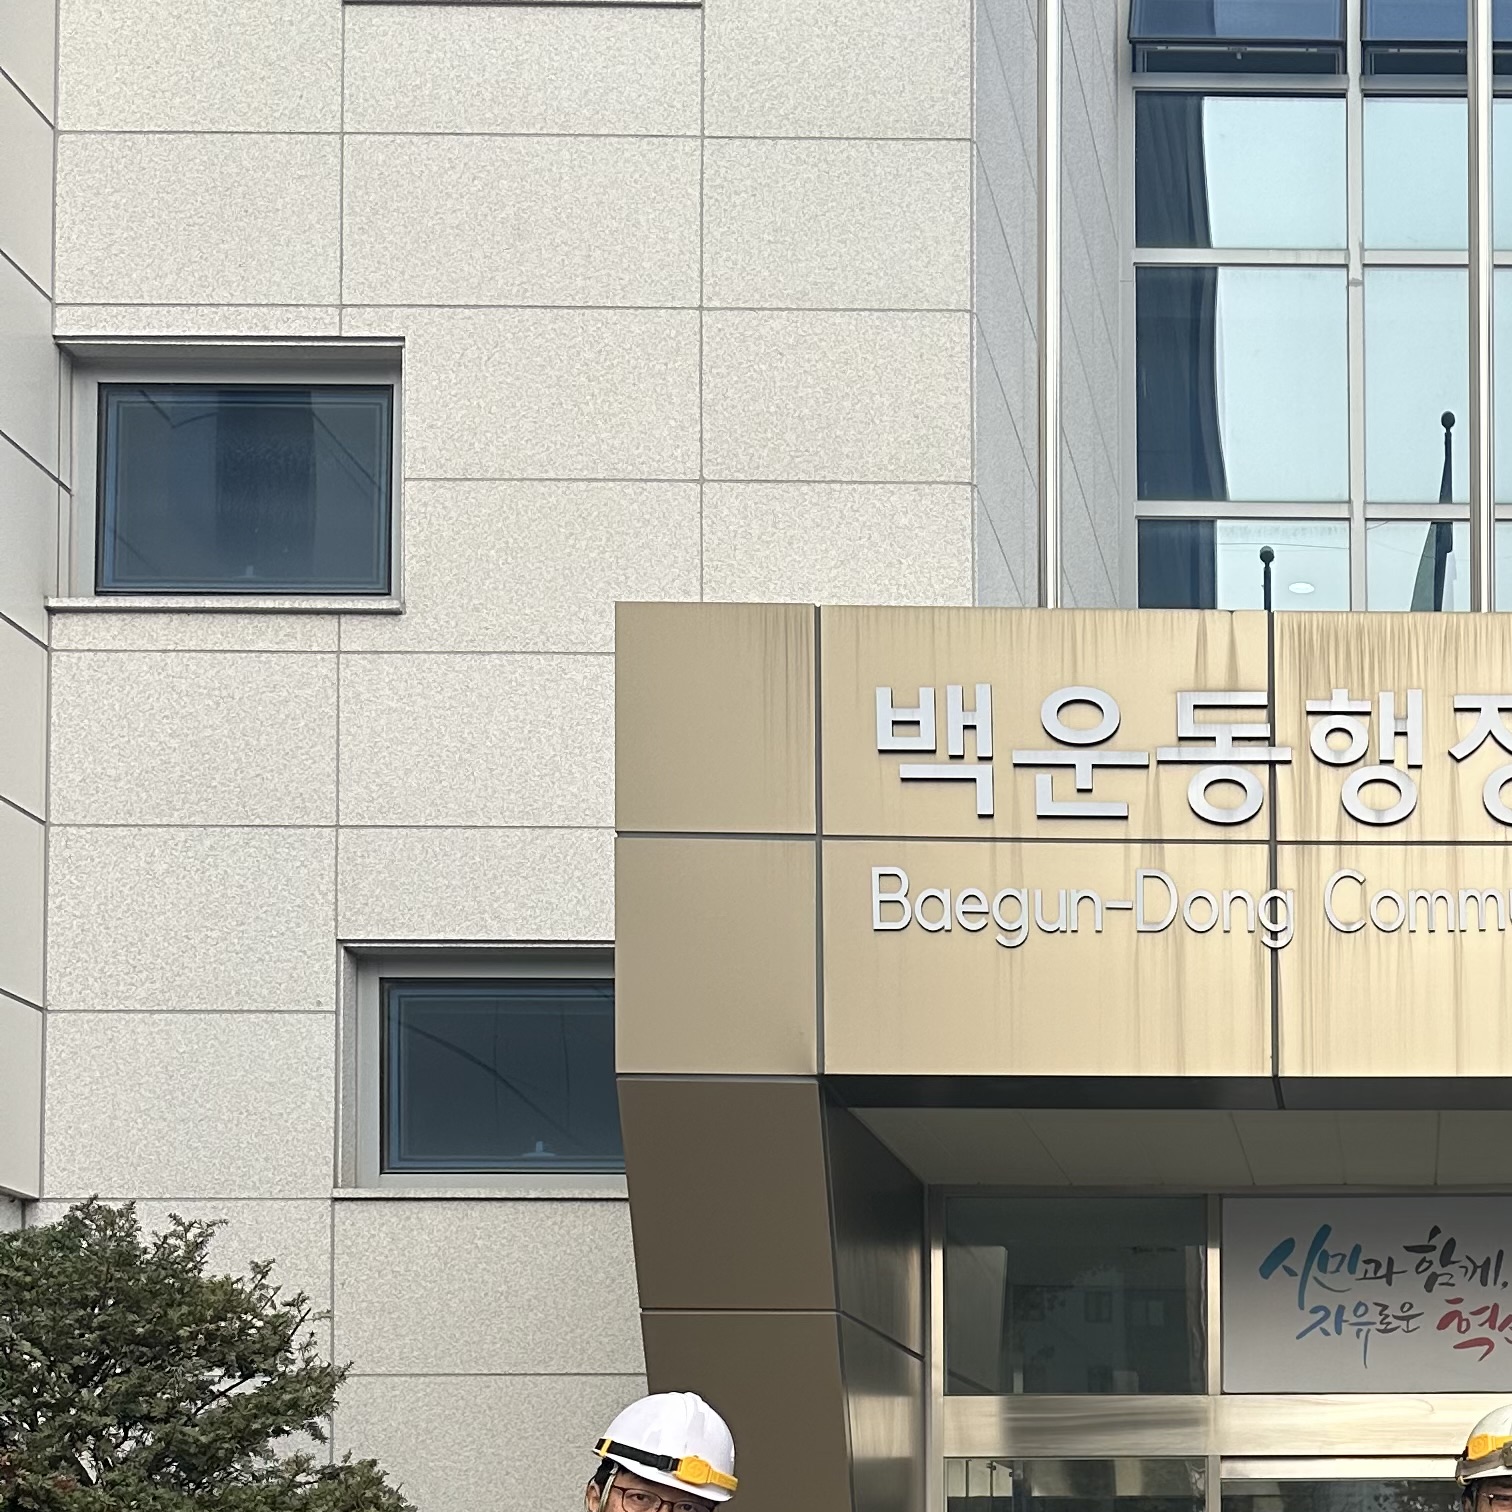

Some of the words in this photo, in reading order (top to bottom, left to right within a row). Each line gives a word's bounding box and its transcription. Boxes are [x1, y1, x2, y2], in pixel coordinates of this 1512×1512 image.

[871, 866, 1295, 948] Baegun-Dong
[1259, 1224, 1407, 1310] 시민과
[1296, 1301, 1425, 1369] 자유로운
